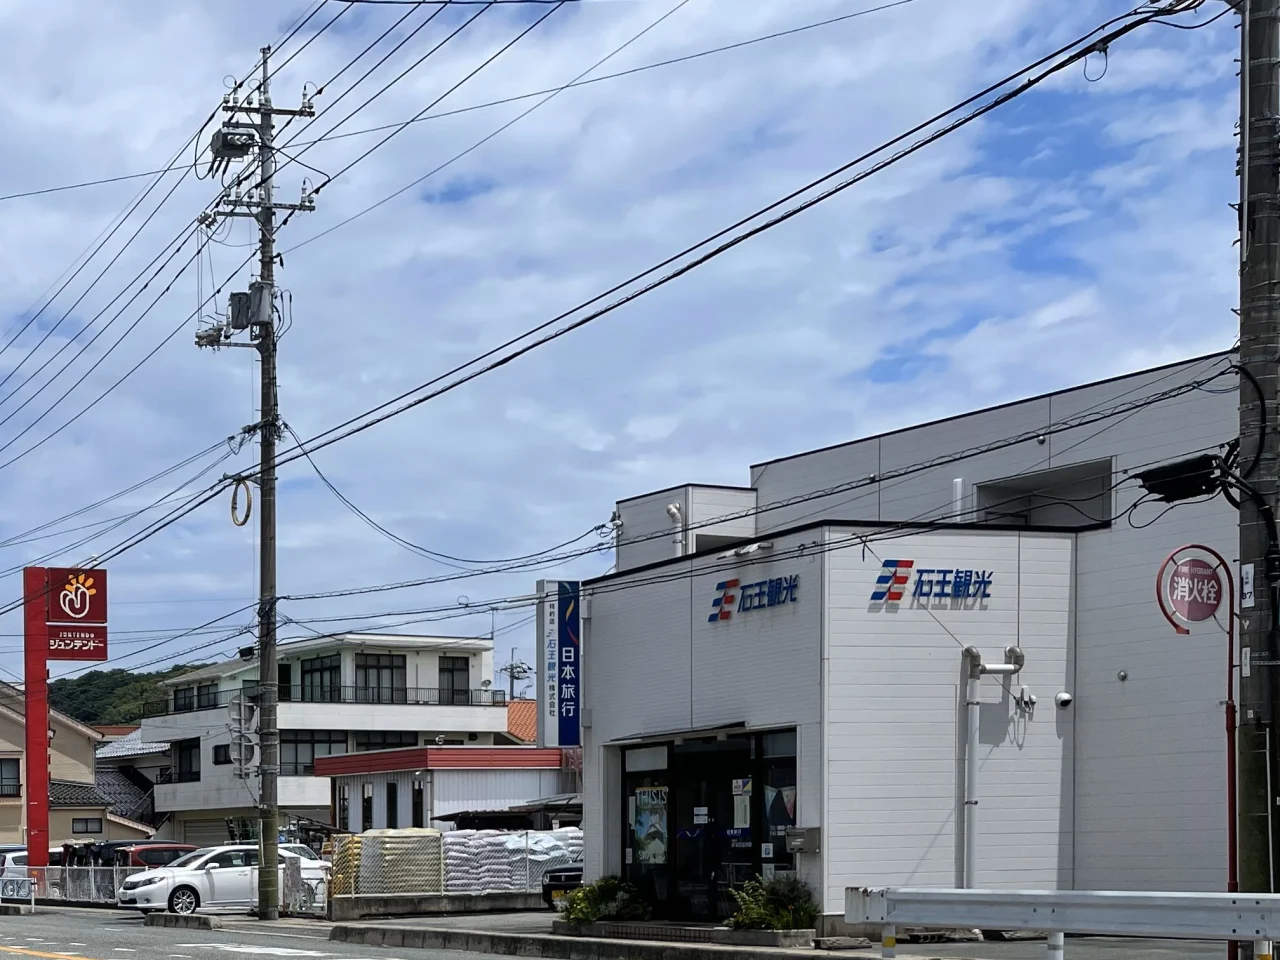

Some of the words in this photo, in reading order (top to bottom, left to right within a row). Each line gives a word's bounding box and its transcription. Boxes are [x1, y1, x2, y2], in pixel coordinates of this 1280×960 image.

[737, 574, 798, 613] 石王観光
[911, 568, 993, 599] 石王観光
[1173, 577, 1218, 604] 消火栓
[50, 640, 104, 650] ジュンテンドー
[546, 638, 557, 683] 石王観光
[560, 647, 576, 717] 日本旅行
[548, 684, 556, 717] 株式会社
